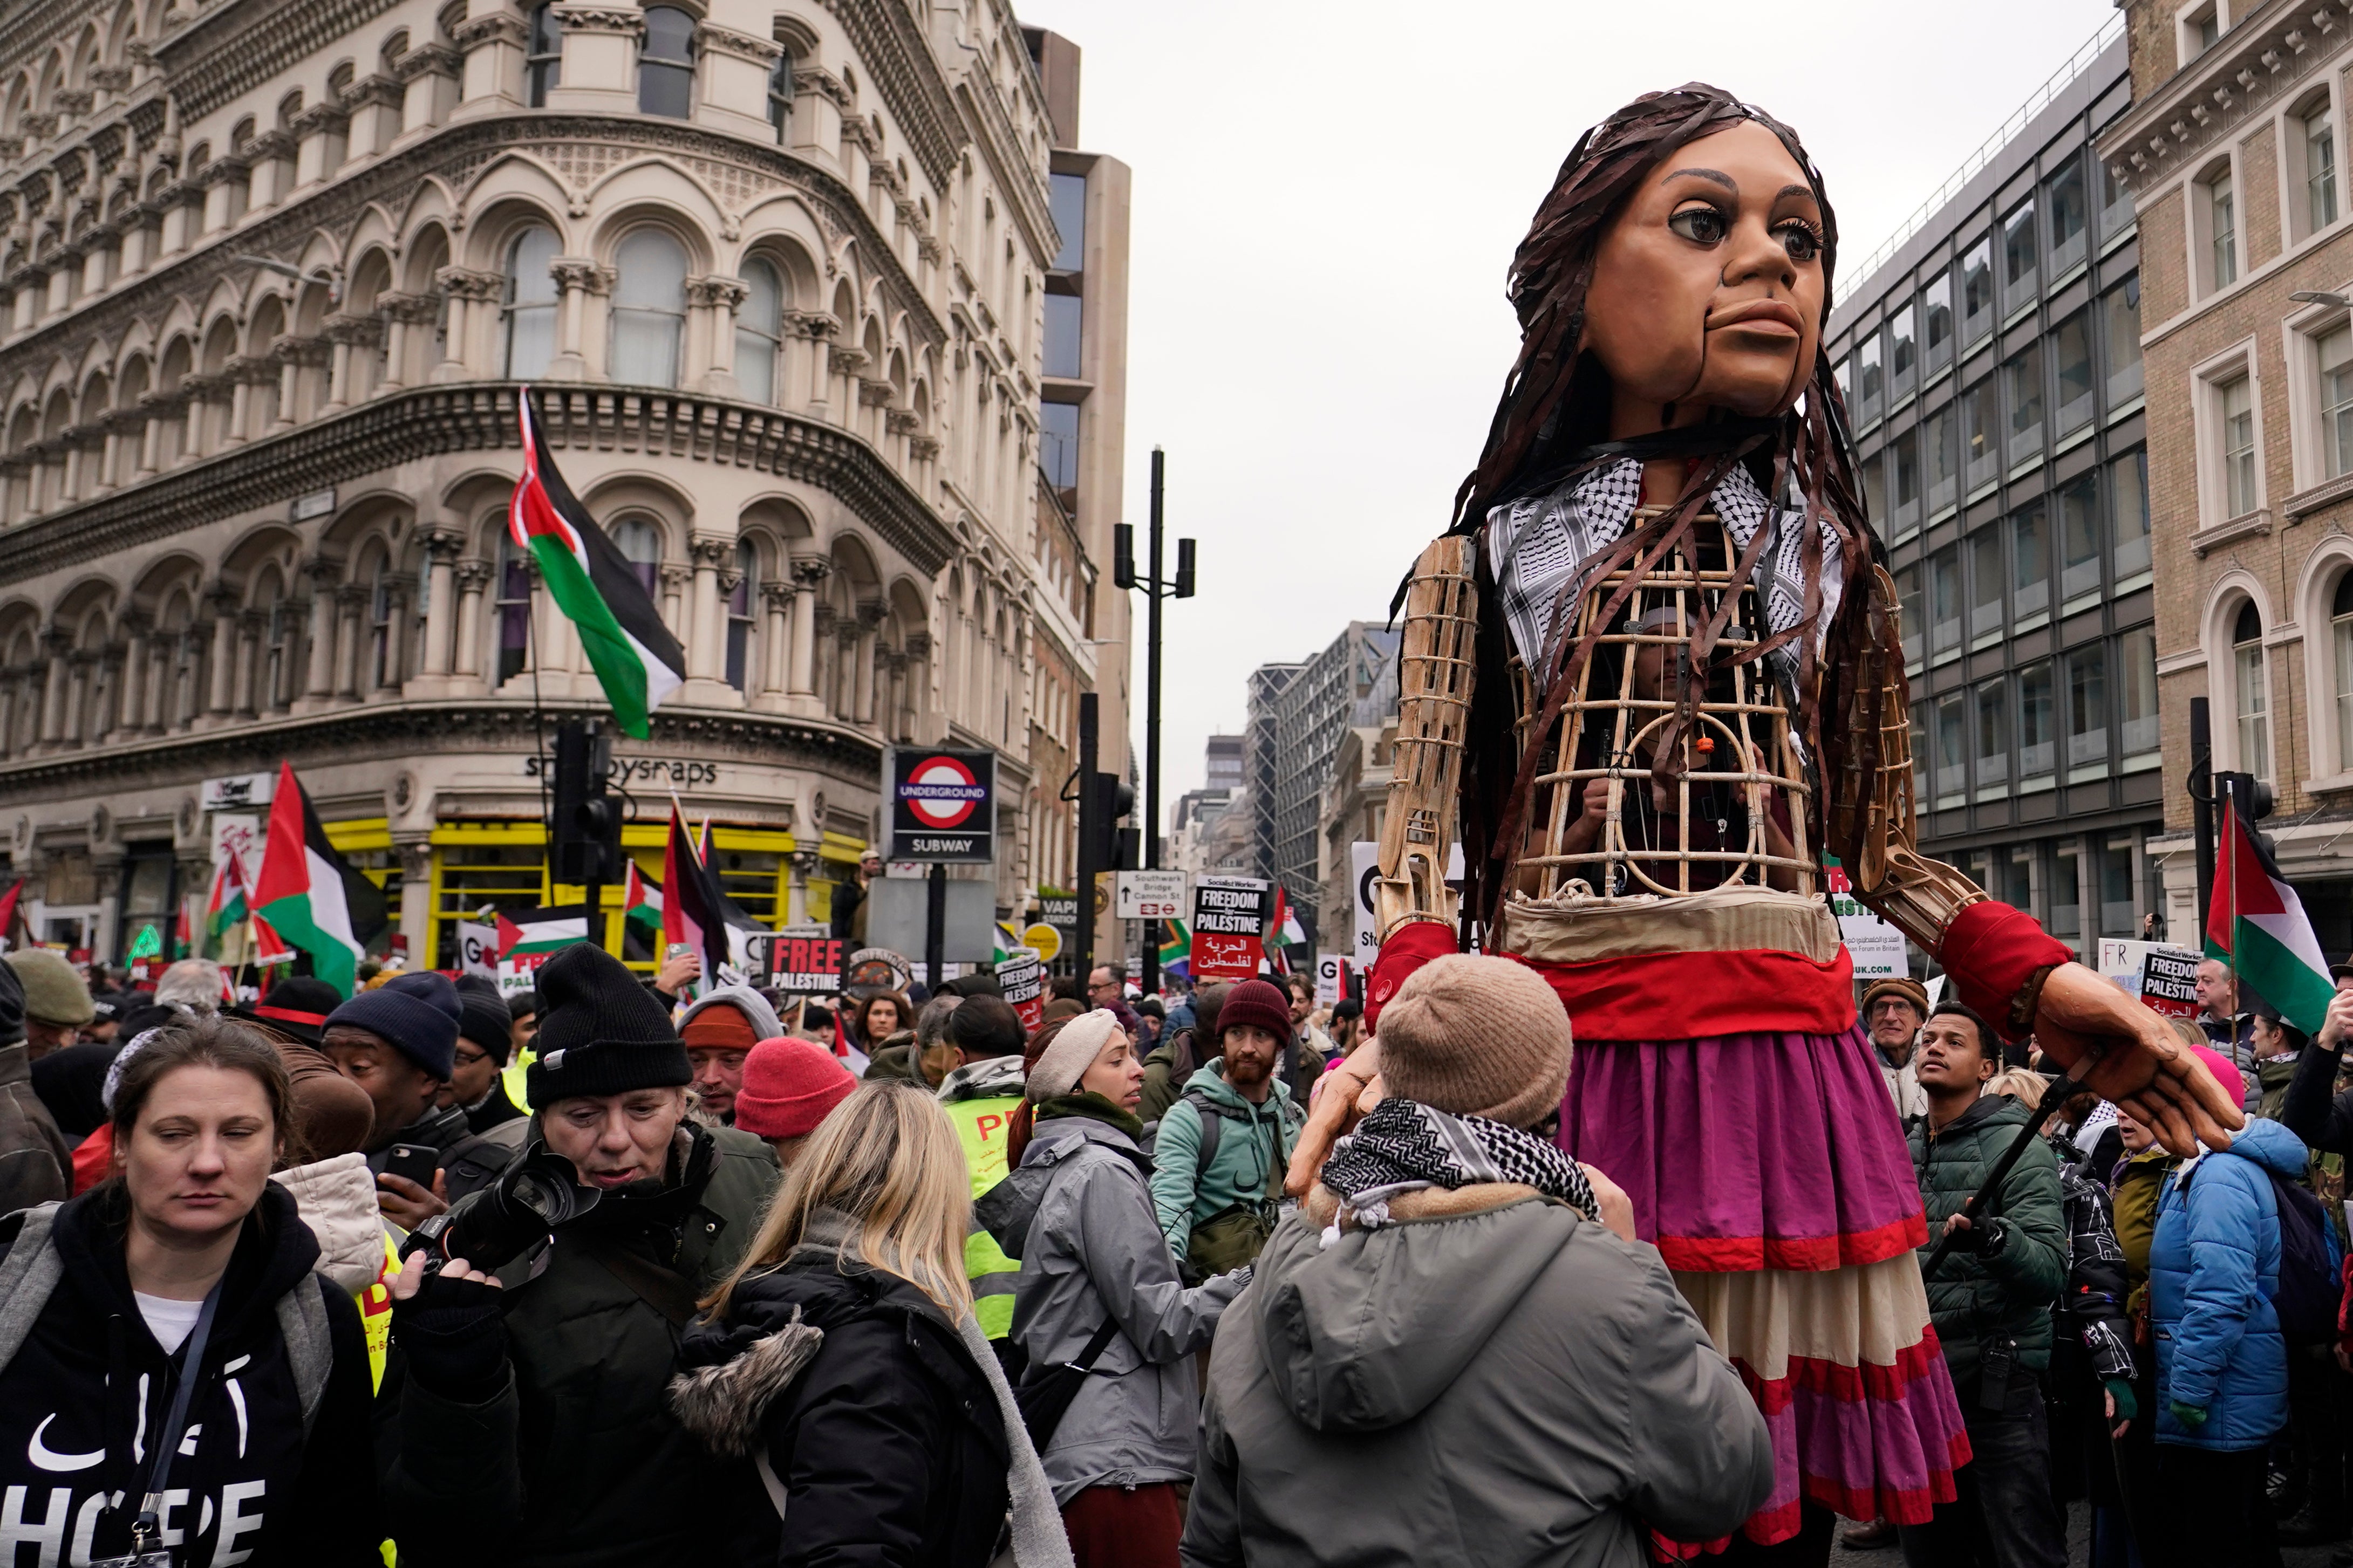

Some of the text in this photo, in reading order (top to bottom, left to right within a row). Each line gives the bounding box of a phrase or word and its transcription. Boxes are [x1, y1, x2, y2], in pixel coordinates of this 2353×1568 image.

[899, 786, 985, 798] UNDERGROUND
[912, 838, 973, 852] SUBWAY
[1144, 884, 1172, 892] Bridge
[1208, 878, 1257, 888] Socialist Worker
[1201, 889, 1259, 909] FREEDOM
[1224, 907, 1235, 916] for
[1196, 913, 1261, 933] PALESTINE
[1205, 936, 1247, 954] الحرية
[2156, 948, 2181, 957] Socialist
[773, 938, 843, 974] FREE
[1198, 953, 1251, 968] لفلسطين
[1000, 963, 1039, 987] FREEDOM
[1853, 966, 1892, 974] UK.COM
[770, 972, 841, 990] PALESTINE
[2171, 975, 2181, 984] for
[1004, 981, 1041, 1004] ALESTINE
[2145, 978, 2199, 1001] PALESTIN
[429, 1218, 443, 1234] SONY
